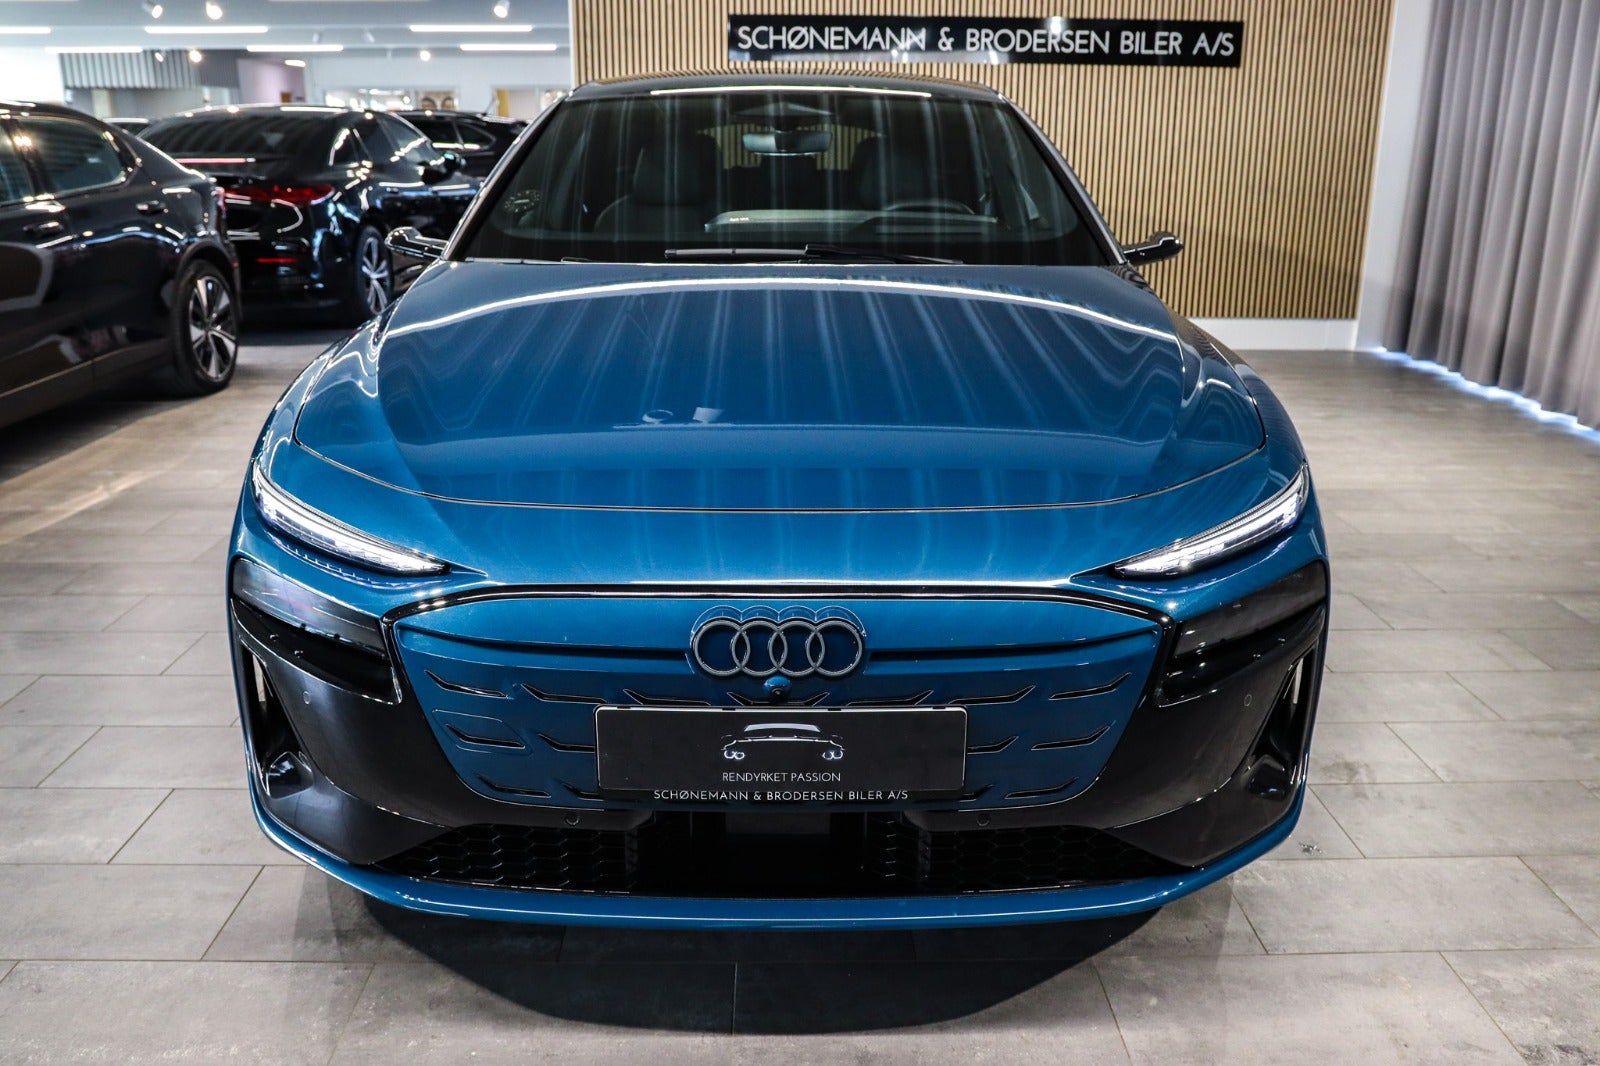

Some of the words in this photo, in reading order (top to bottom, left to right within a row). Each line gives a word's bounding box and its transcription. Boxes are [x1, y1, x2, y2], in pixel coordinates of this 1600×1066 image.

[737, 25, 927, 51] SCHØNEMANN
[937, 26, 955, 51] &
[965, 27, 1110, 54] BRODERSEN
[1120, 30, 1183, 55] BILER
[1192, 33, 1235, 56] A/S
[722, 772, 788, 782] RENDYRKET
[790, 772, 841, 782] PASSION
[653, 789, 749, 801] SCHØNEMANN
[753, 790, 762, 801] &
[766, 790, 844, 801] BRODERSEN
[848, 790, 883, 801] BILER
[887, 789, 908, 800] A/S
